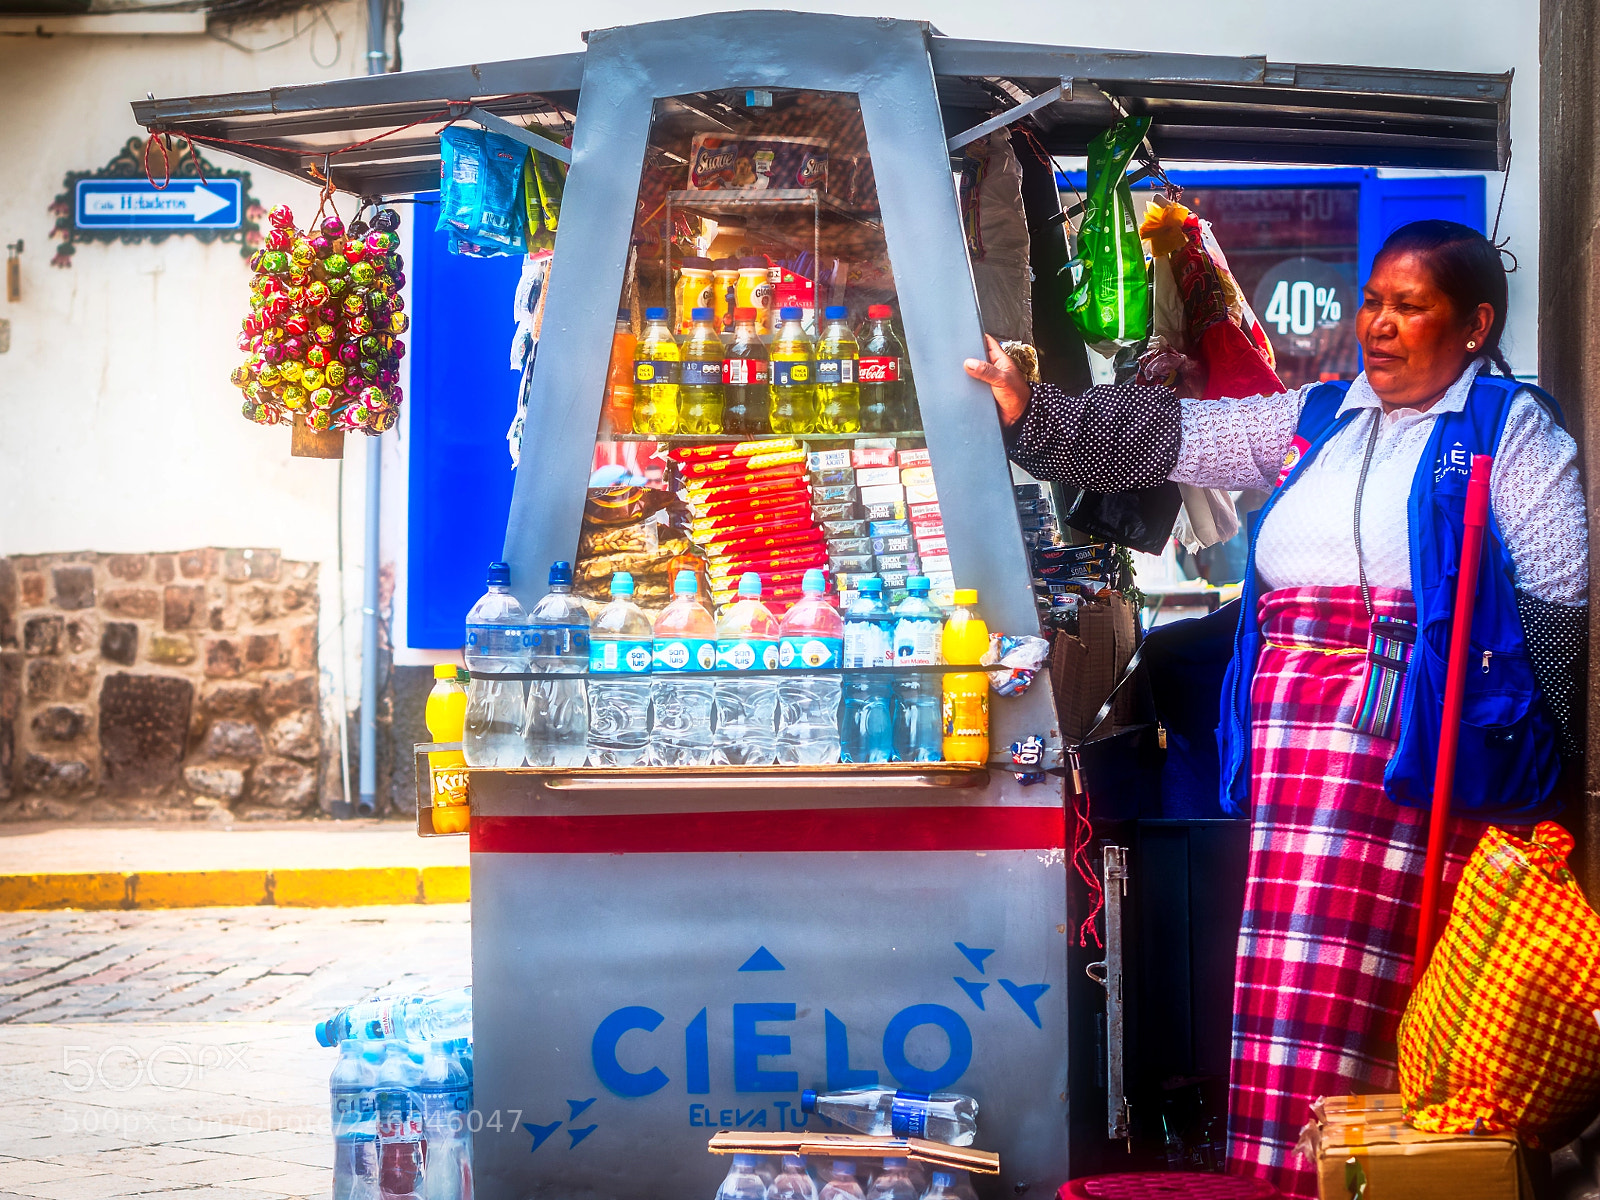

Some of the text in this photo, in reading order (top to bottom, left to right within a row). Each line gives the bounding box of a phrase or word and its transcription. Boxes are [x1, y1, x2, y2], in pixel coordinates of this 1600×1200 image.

[697, 150, 733, 174] Suave
[1265, 280, 1341, 335] 40%
[632, 659, 645, 667] luis
[669, 656, 684, 664] luis
[735, 656, 750, 664] luis
[688, 1103, 767, 1127] ELEVA
